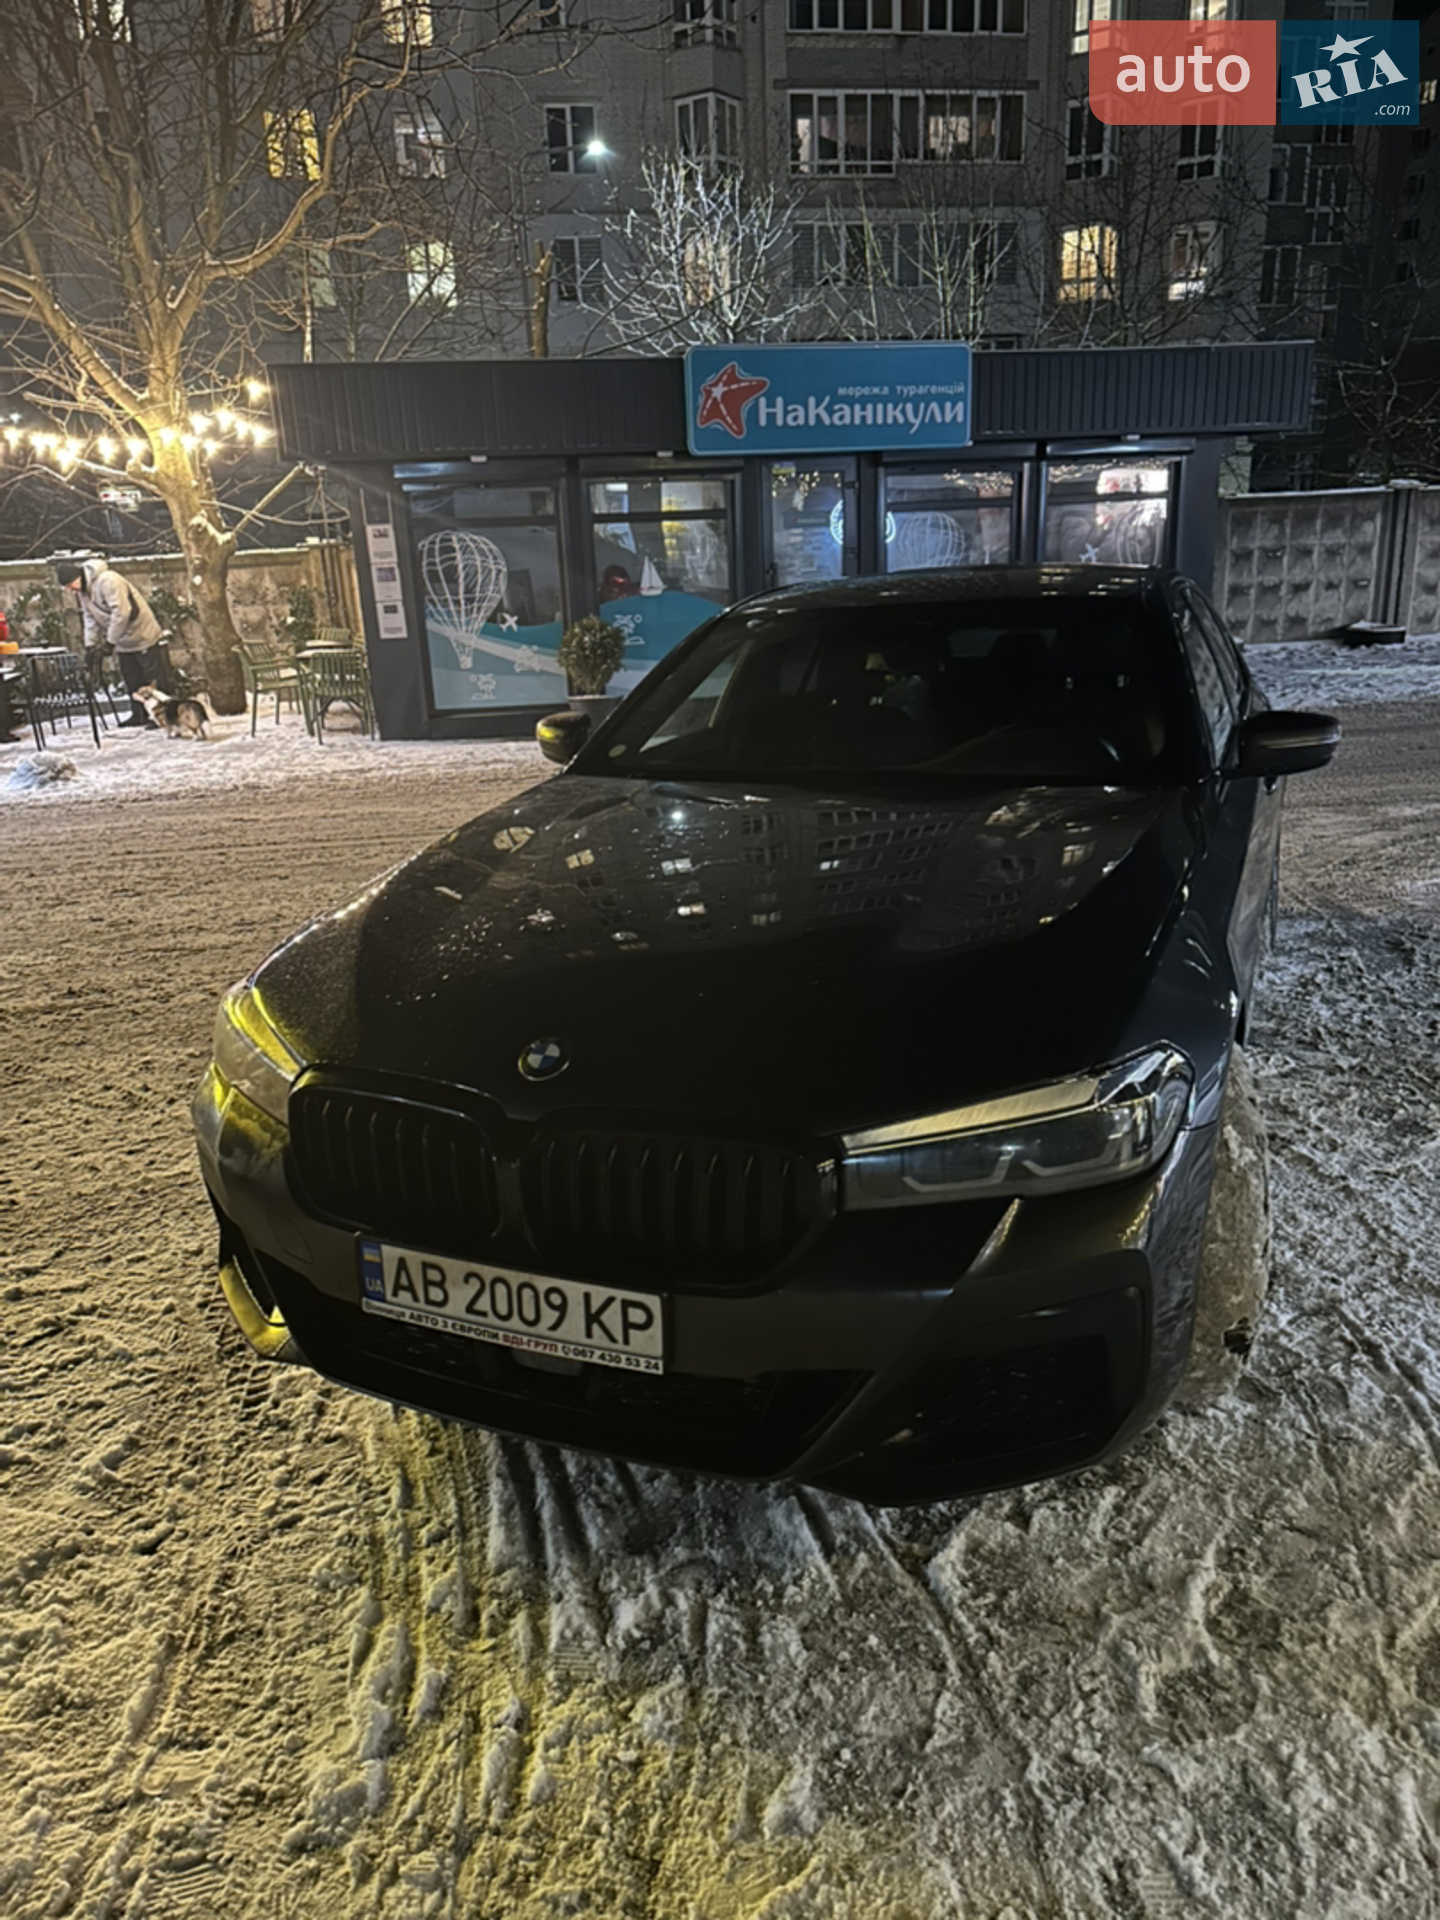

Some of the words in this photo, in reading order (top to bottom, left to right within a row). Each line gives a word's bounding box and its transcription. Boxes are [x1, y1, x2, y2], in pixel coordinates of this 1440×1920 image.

[837, 385, 889, 398] мережа
[896, 382, 965, 397] турагенцій
[759, 396, 964, 433] НаКанікули
[365, 1277, 384, 1294] UA
[391, 1256, 449, 1308] AB
[463, 1272, 569, 1331] 2009
[583, 1291, 655, 1346] KP
[408, 1311, 439, 1326] АВТО
[599, 1353, 622, 1364] 430
[645, 1360, 661, 1371] 24
